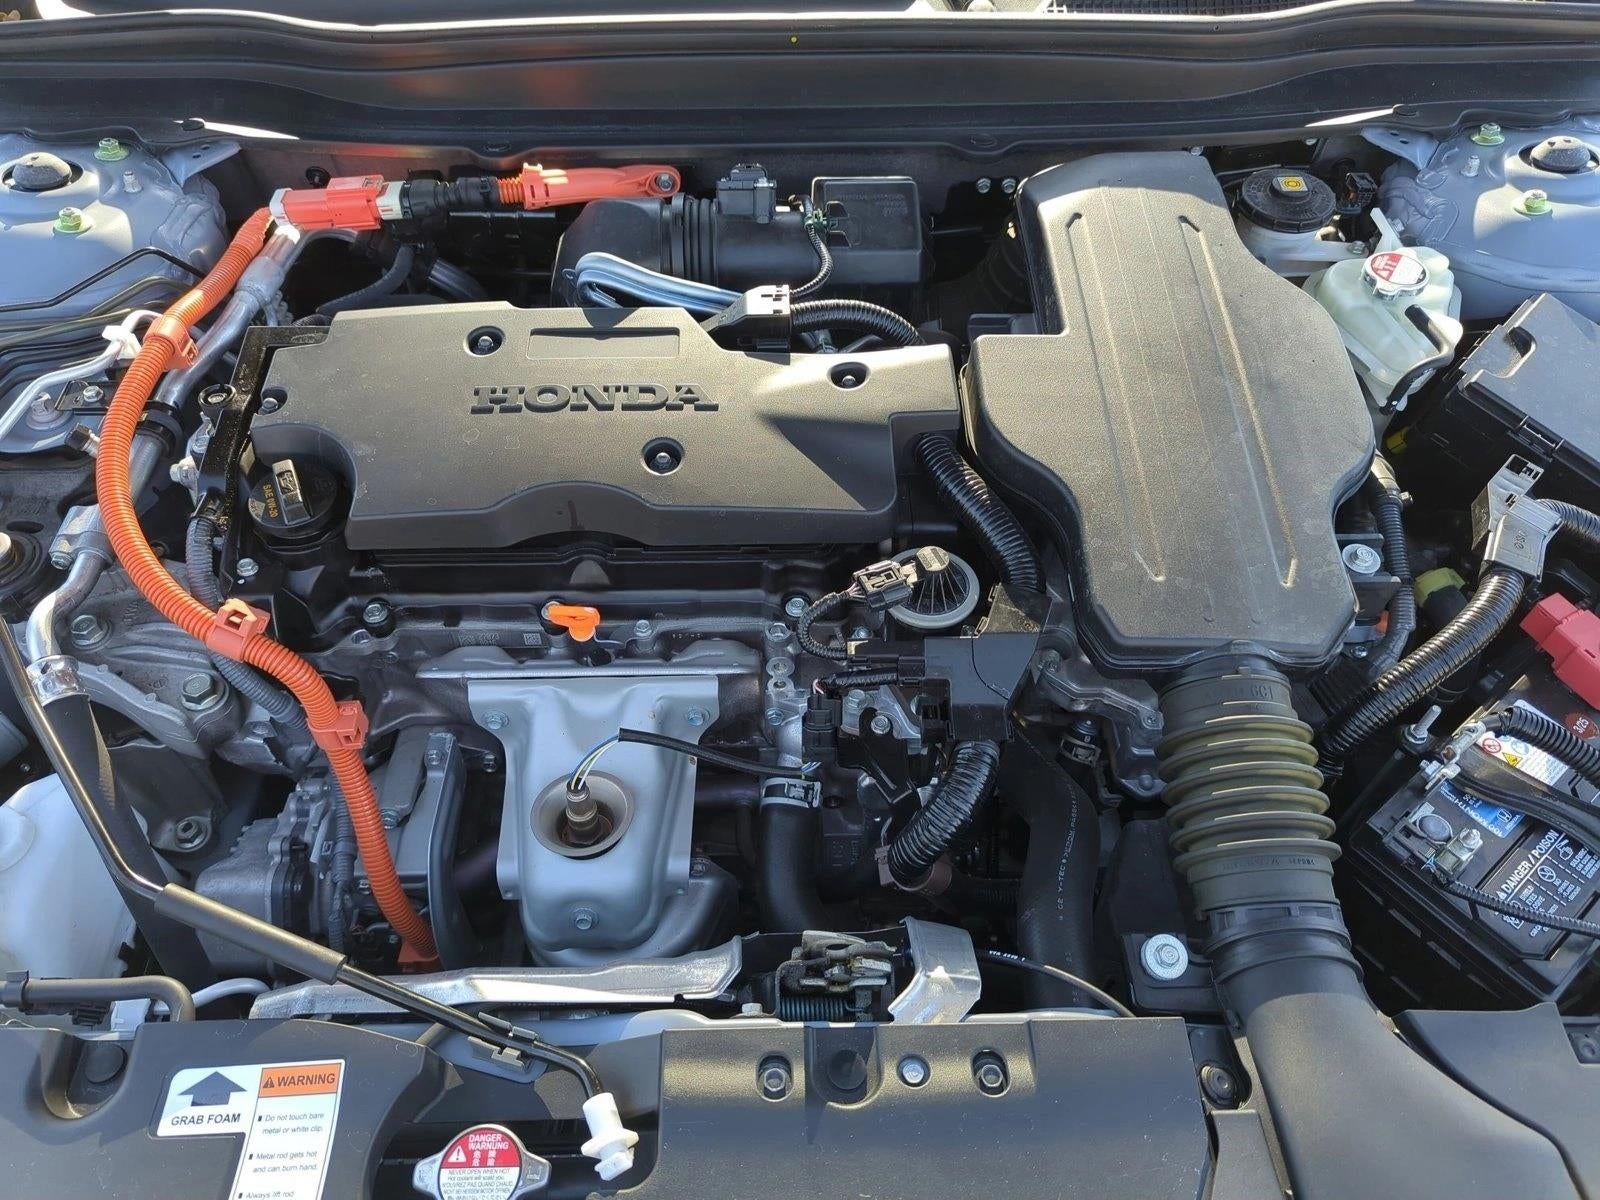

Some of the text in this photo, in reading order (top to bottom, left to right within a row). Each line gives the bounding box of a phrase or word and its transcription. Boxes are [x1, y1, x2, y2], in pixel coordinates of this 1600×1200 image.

[471, 384, 719, 414] HONDA
[263, 484, 273, 498] SAE
[1572, 716, 1590, 734] 3/25
[1454, 798, 1489, 830] MONTH
[1488, 824, 1504, 837] 100
[1500, 829, 1560, 893] DANGER / POISON
[277, 1073, 335, 1087] WARNING
[170, 1113, 241, 1126] GRAB FOAM
[469, 1133, 503, 1142] DANGER
[468, 1141, 509, 1150] WARNUNG
[289, 1151, 304, 1160] gets
